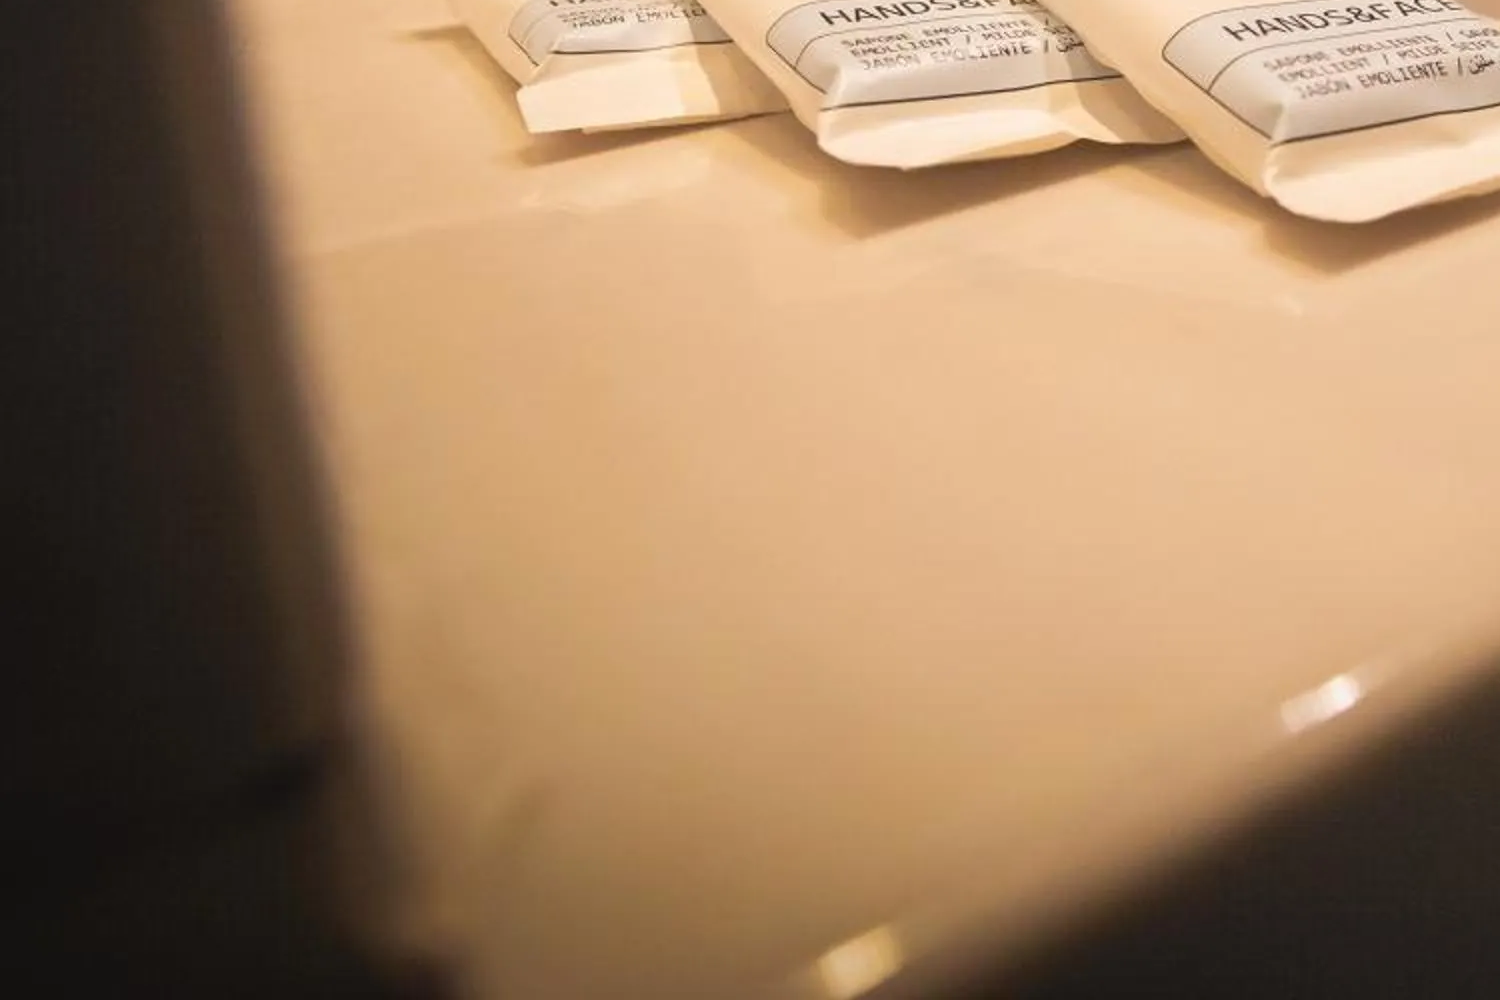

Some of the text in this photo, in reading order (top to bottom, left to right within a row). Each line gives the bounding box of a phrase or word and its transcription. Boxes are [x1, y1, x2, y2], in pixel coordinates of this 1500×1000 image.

[1263, 49, 1331, 72] SAPONE
[1335, 34, 1440, 58] EMOLLIENTE
[1277, 55, 1372, 83] EMOLLIENT
[1395, 44, 1448, 62] MILDE
[1294, 75, 1352, 101] JABÓN
[1356, 59, 1450, 89] EMOLIENTE
